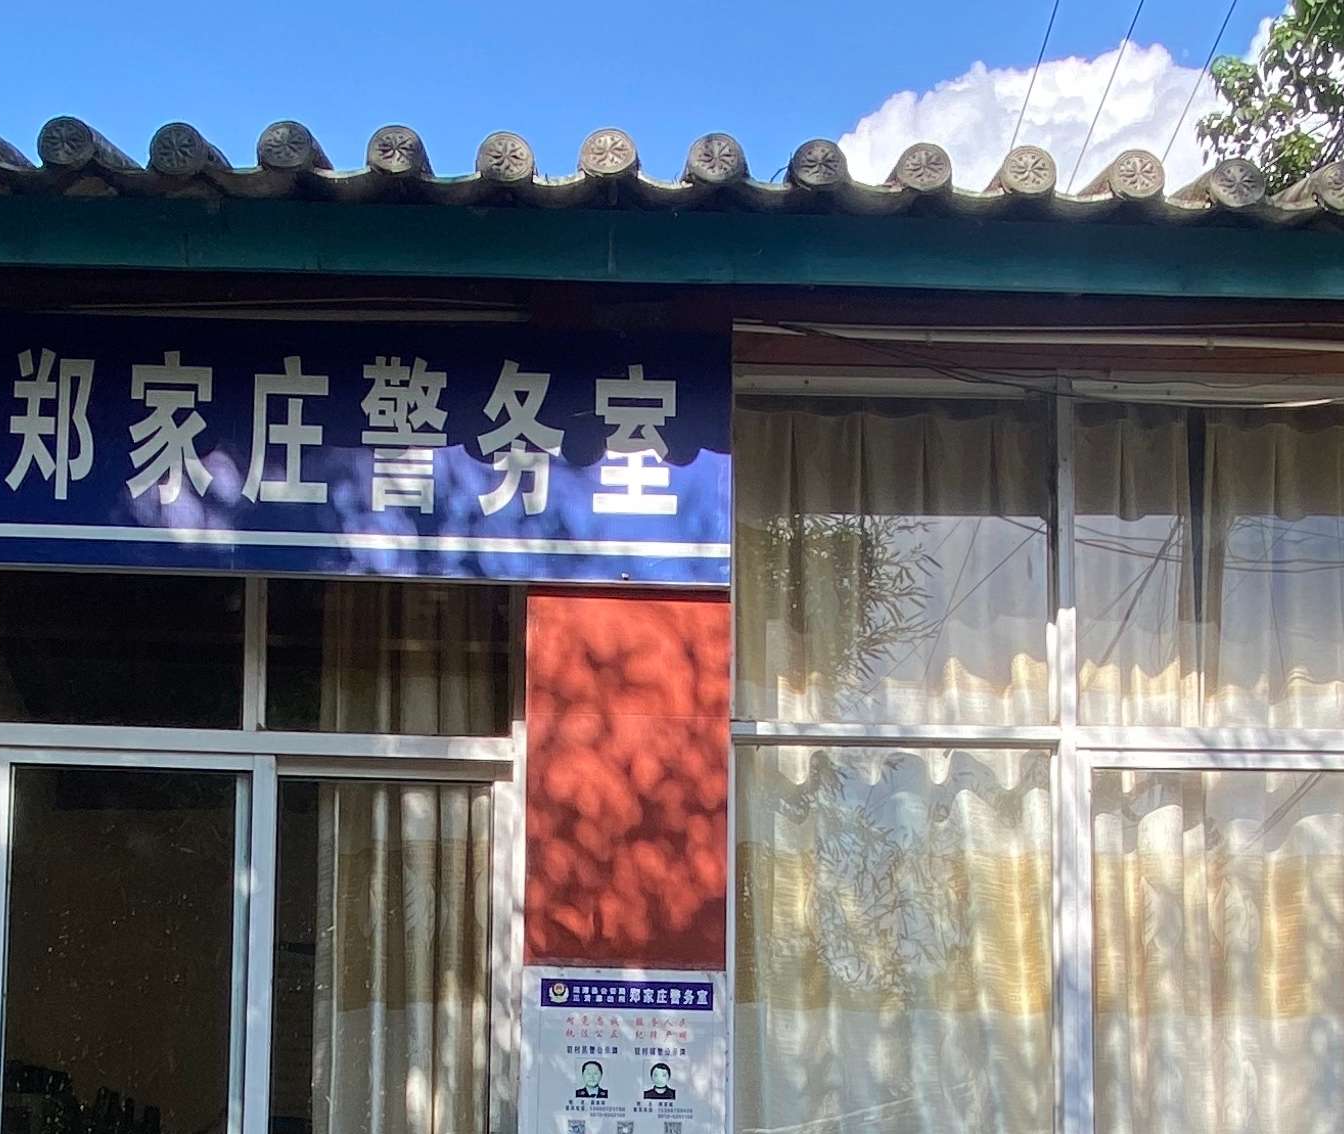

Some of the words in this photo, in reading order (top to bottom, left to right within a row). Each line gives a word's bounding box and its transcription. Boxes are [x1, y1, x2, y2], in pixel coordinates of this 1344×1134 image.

[4, 347, 678, 516] 郑家庄警务室
